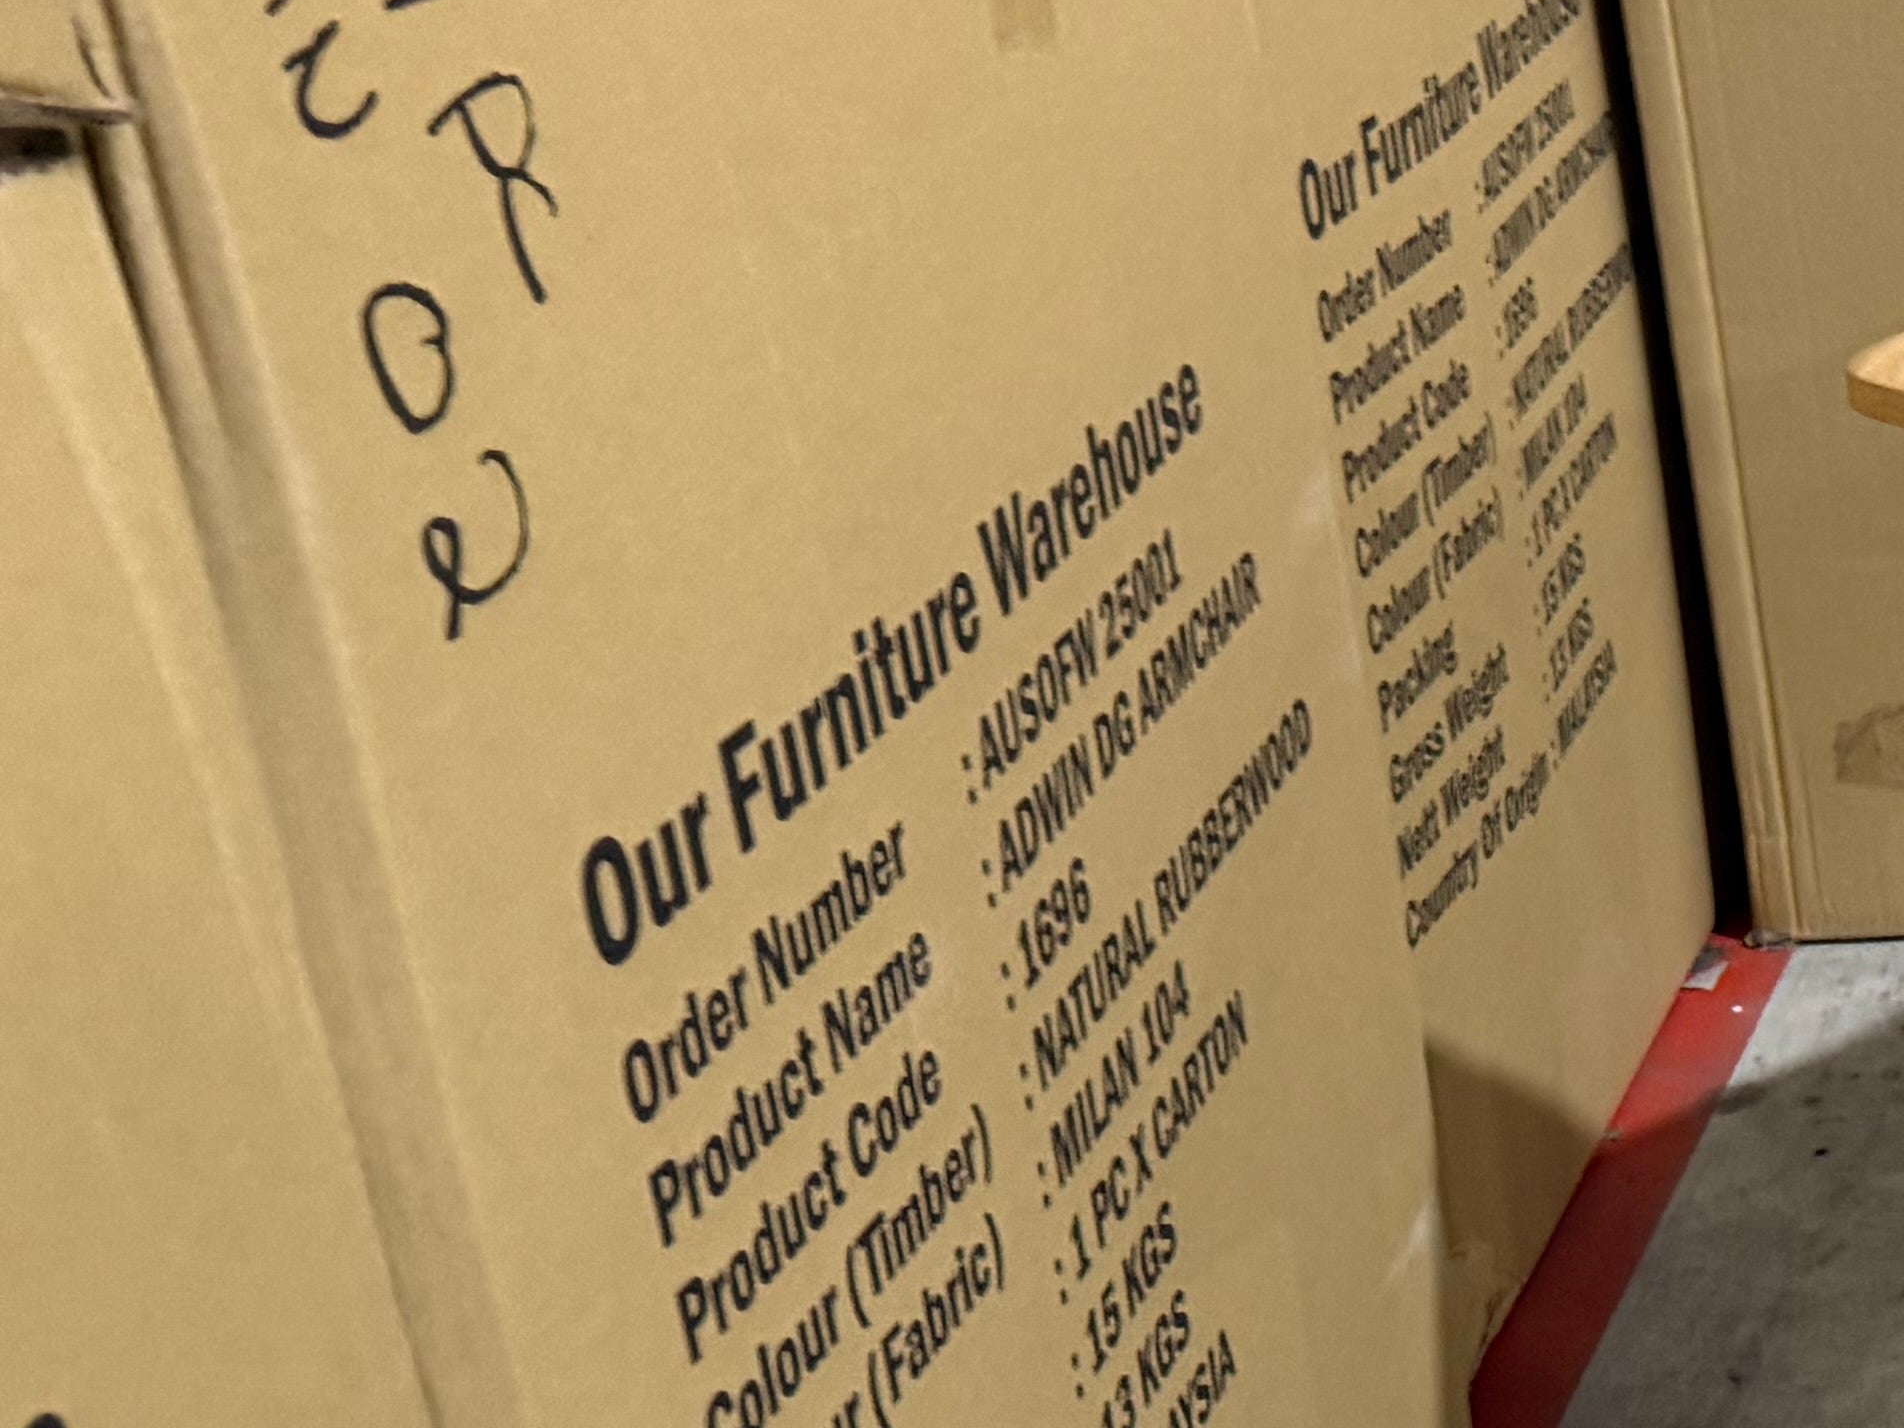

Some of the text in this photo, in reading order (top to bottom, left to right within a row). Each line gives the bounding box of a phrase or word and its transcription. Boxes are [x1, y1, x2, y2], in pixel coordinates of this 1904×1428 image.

[1299, 150, 1359, 241] Our
[1360, 61, 1481, 197] Furniture
[581, 364, 1203, 966] Our Furniture Warehouse
[1376, 619, 1459, 734] Packing
[621, 967, 749, 1124] Order
[750, 821, 906, 1006] Number
[980, 608, 1099, 790] AUSOFW
[1099, 529, 1183, 660] 25001
[648, 1027, 825, 1249] Product
[828, 932, 931, 1074] Name
[999, 734, 1095, 893] ADWIN
[1096, 690, 1137, 780] DG
[1138, 552, 1262, 735] ARMCHAIR
[674, 1138, 848, 1366] Product
[847, 1050, 942, 1178] Code
[1017, 857, 1091, 991] 1696
[845, 1103, 993, 1329] (Timber)
[1032, 899, 1156, 1092] NATURAL
[1154, 698, 1312, 936] RUBBERWOOD
[1050, 1026, 1140, 1188] MILAN
[1141, 960, 1190, 1066] 104
[1069, 1213, 1092, 1282] 1
[1090, 1155, 1130, 1250] PC
[1130, 1122, 1154, 1196] X
[1152, 990, 1248, 1159] CARTON
[1086, 1279, 1123, 1376] 15
[1122, 1201, 1177, 1318] KGS
[1137, 1289, 1191, 1408] KGS
